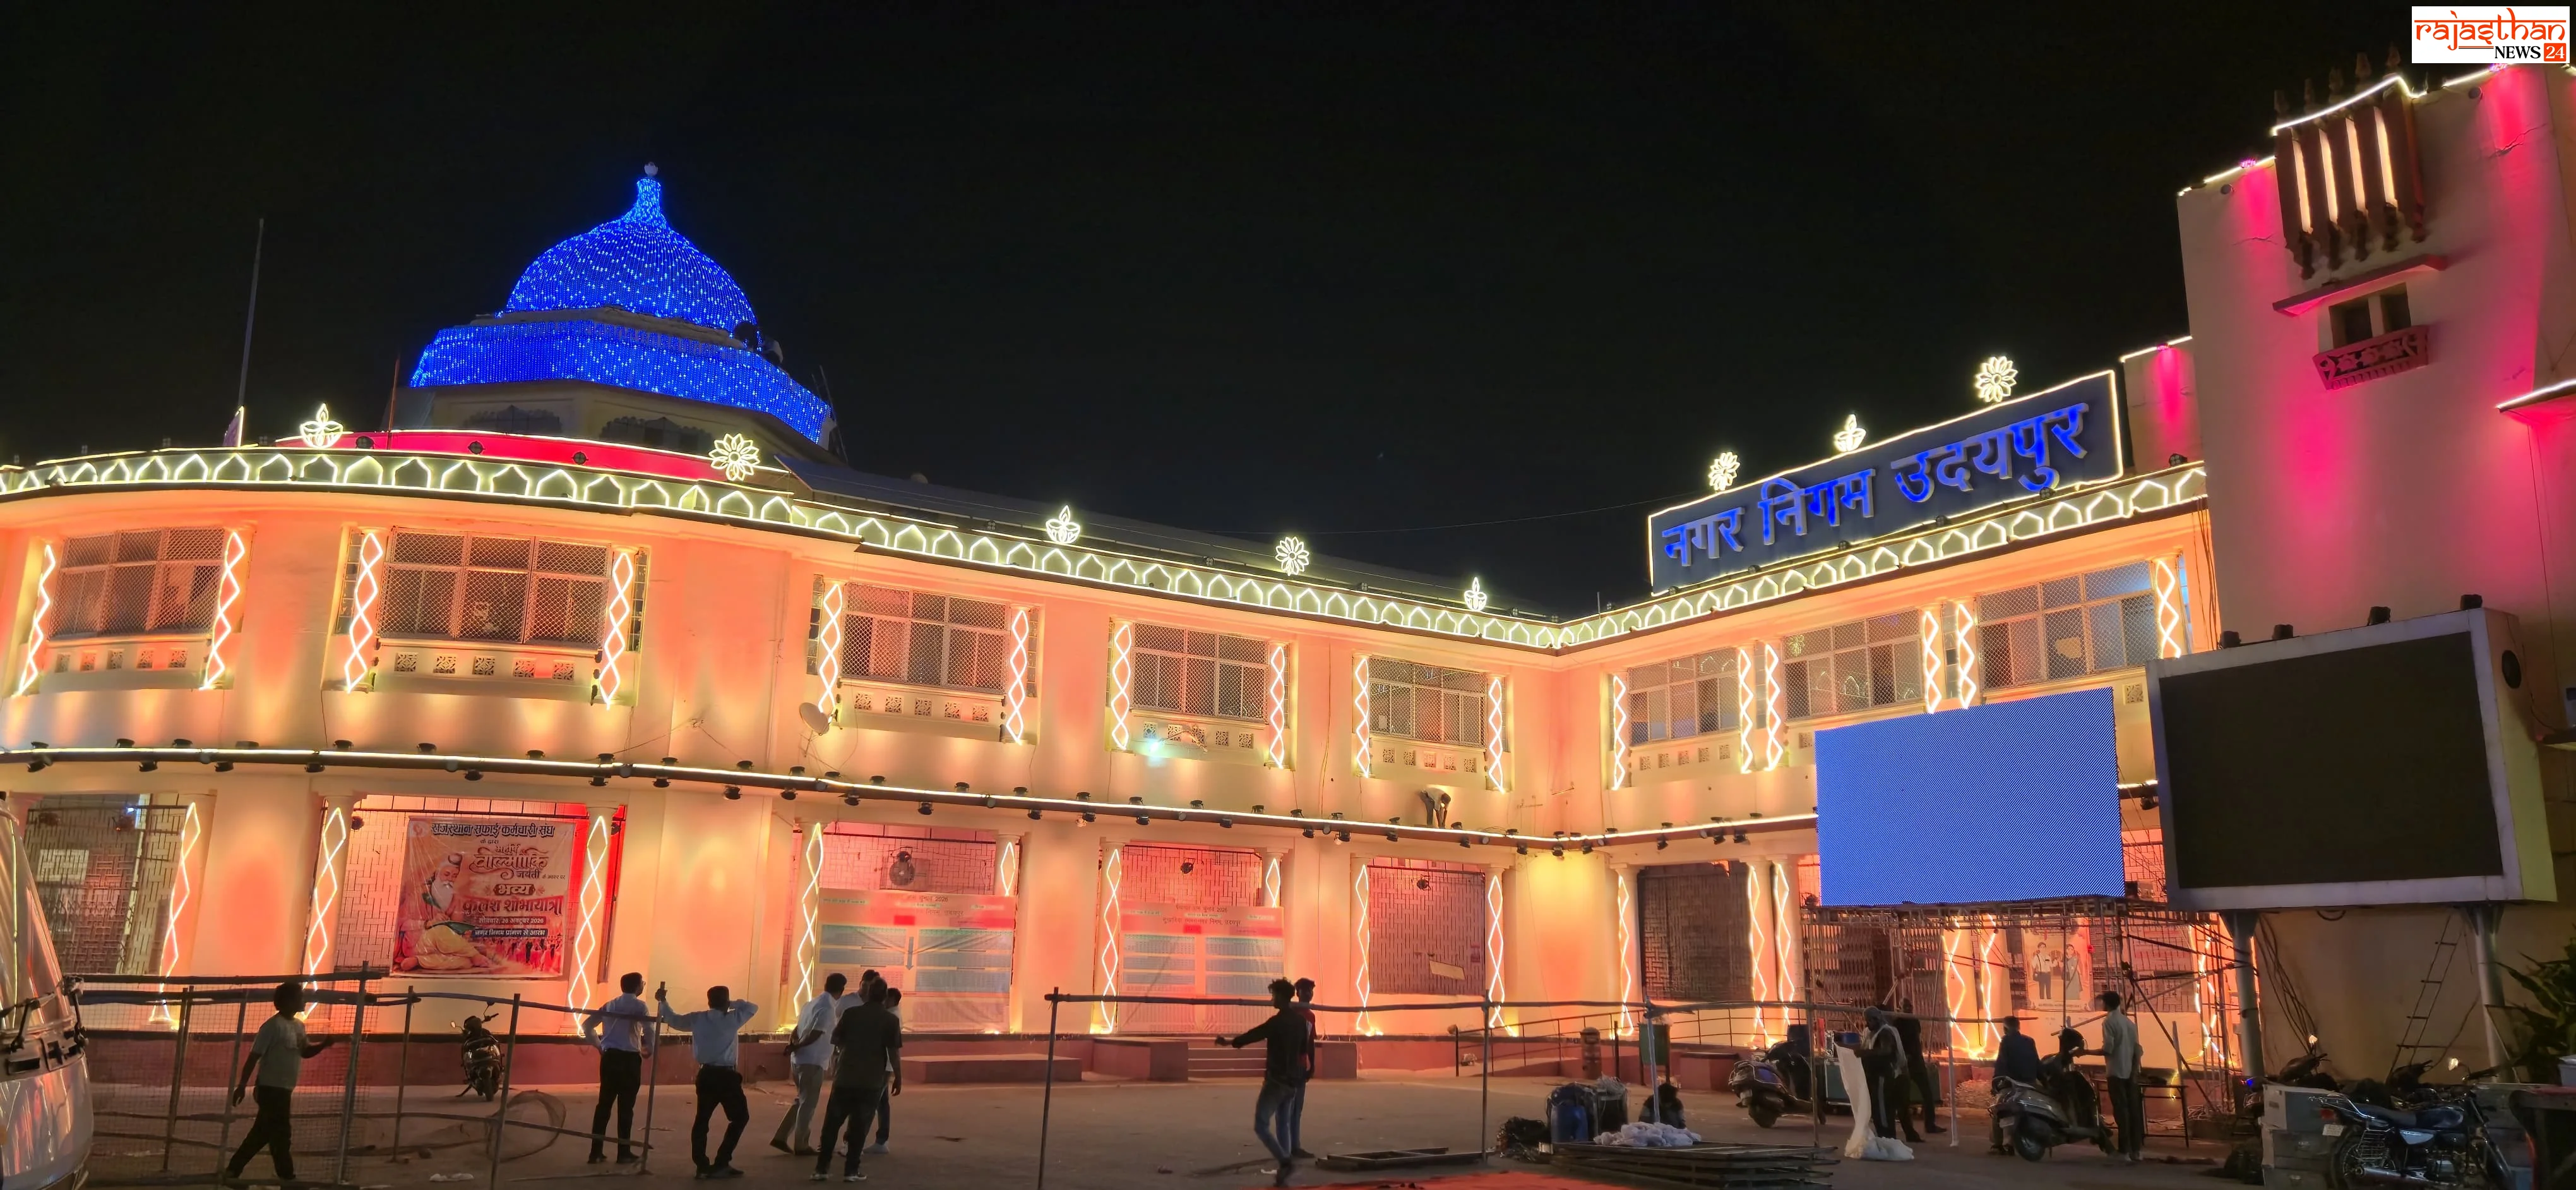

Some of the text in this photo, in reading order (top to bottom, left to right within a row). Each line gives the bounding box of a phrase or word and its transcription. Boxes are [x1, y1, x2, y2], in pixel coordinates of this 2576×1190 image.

[1662, 402, 2089, 567] नगर निगम उदयपुर
[432, 822, 555, 838] राजस्थान सफाई कर्मचारी संघ
[516, 869, 542, 879] जयंती
[498, 884, 532, 895] भव्य
